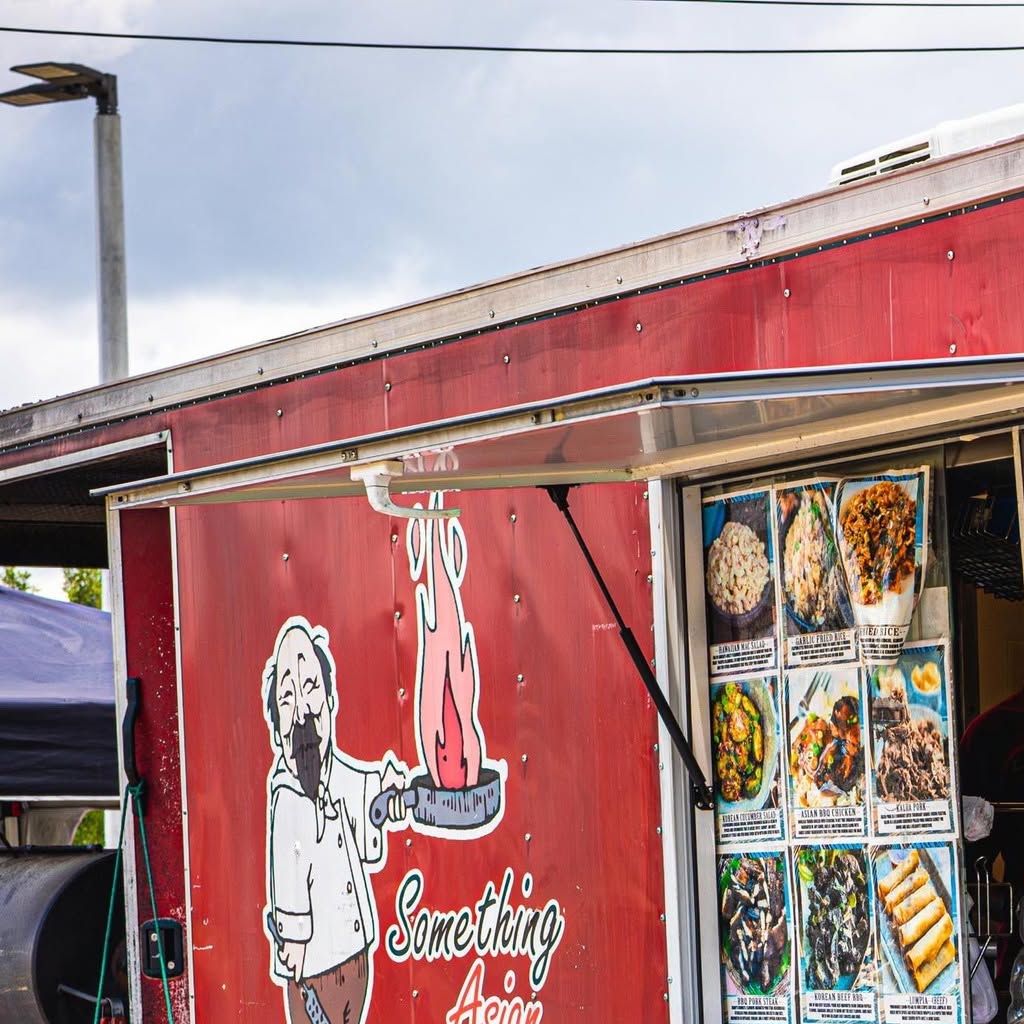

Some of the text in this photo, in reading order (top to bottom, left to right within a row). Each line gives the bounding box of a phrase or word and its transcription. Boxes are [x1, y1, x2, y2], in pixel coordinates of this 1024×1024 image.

[801, 807, 856, 818] ASIAN BBQ CHICKEN
[385, 866, 566, 993] Something
[814, 992, 836, 1001] KOREAN
[837, 992, 851, 1001] BEEF
